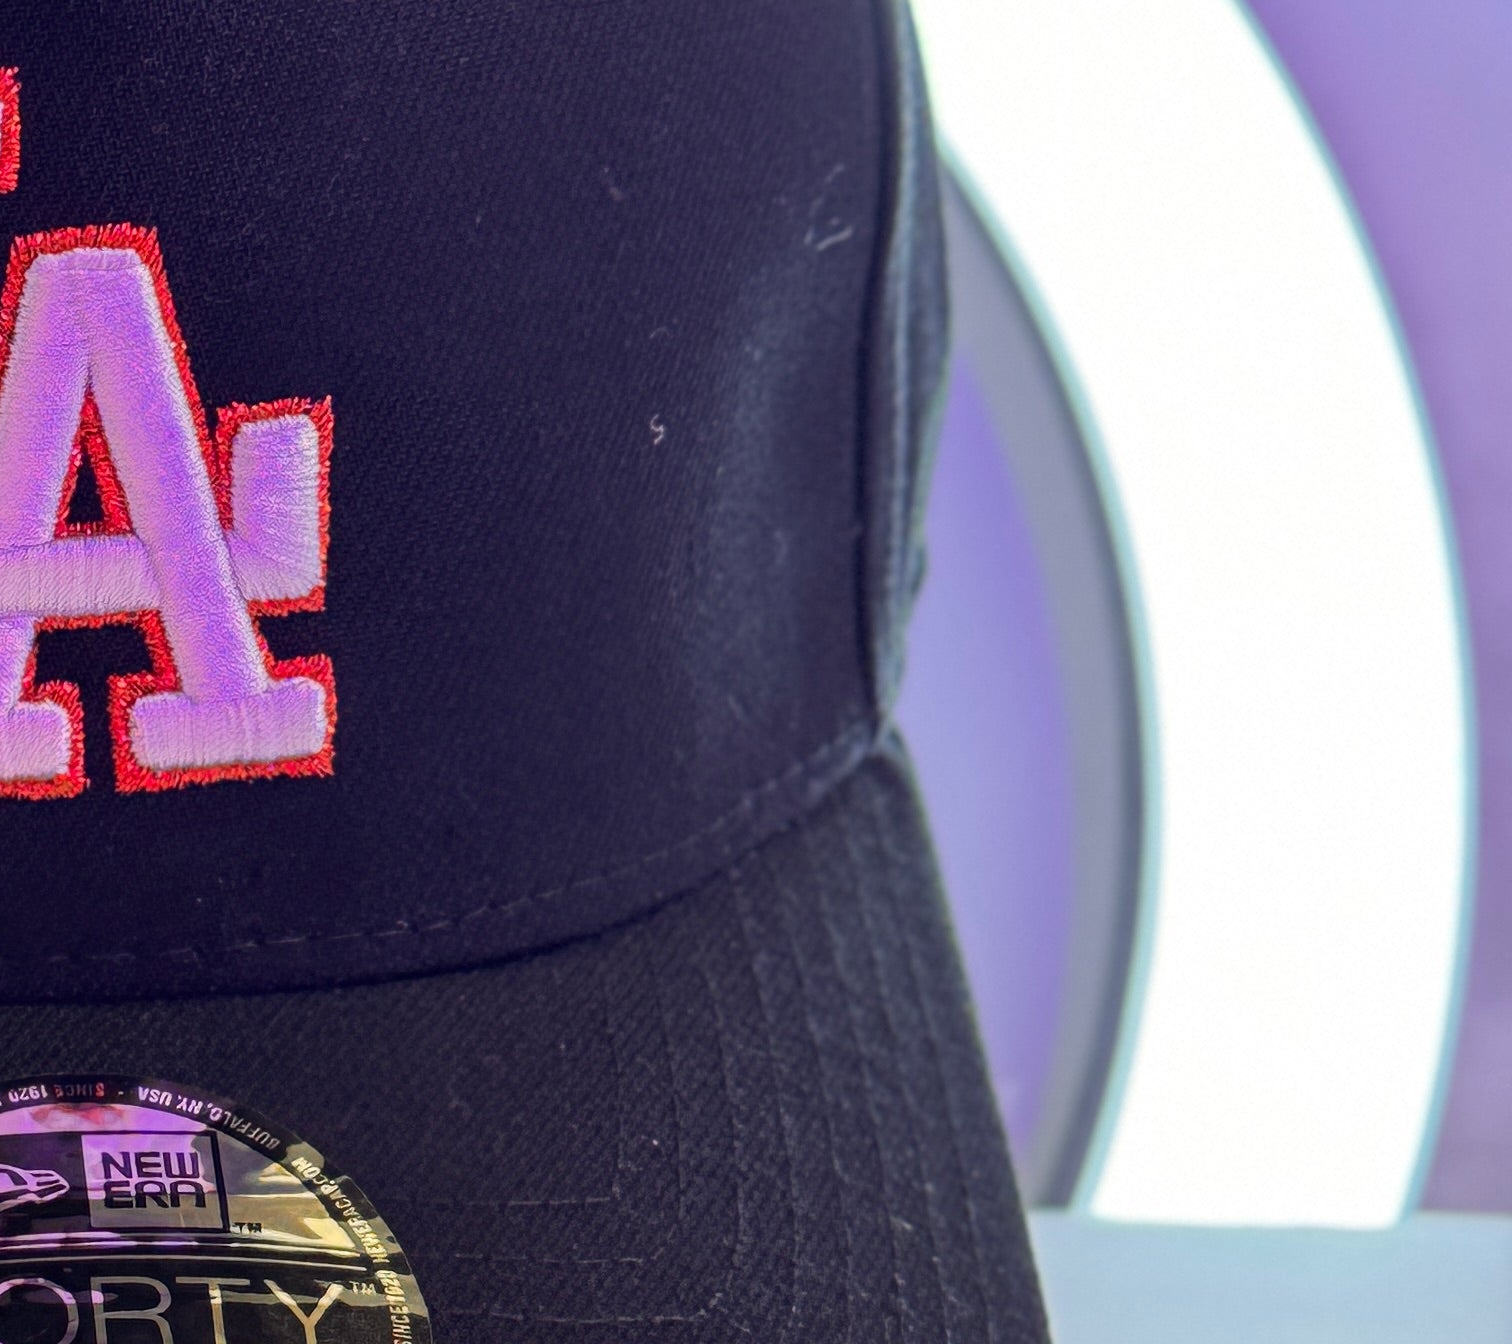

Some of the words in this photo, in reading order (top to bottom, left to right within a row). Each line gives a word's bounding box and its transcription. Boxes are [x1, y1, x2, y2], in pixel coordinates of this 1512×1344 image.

[8, 1084, 48, 1103] 1920
[54, 1082, 105, 1099] SINCE
[138, 1086, 173, 1106] USA
[100, 1150, 201, 1179] NEW
[103, 1180, 207, 1209] ERA
